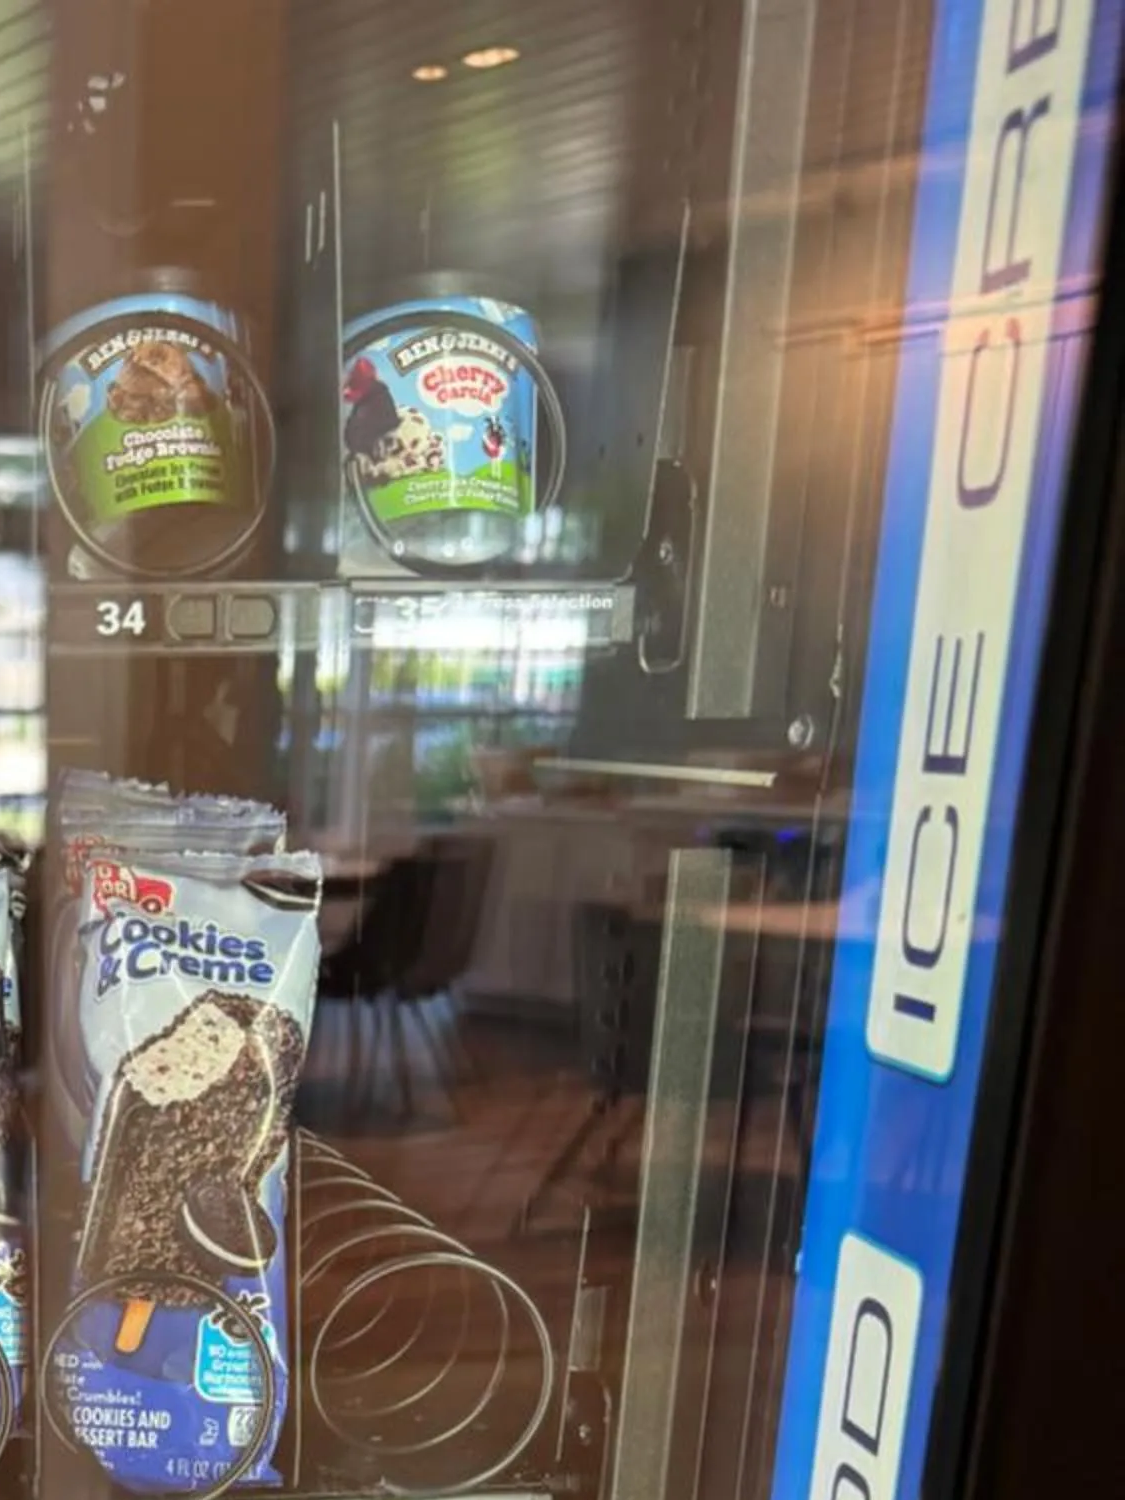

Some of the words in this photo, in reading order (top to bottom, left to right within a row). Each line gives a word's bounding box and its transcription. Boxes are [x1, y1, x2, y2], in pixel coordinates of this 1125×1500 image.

[88, 335, 126, 371] BEN
[397, 334, 440, 368] BEN
[422, 364, 508, 396] Cherry
[436, 385, 494, 406] Garcia
[123, 425, 205, 447] Chocolate
[106, 448, 154, 472] Fudge
[95, 602, 147, 636] 34
[892, 630, 985, 1022] ICE
[100, 918, 266, 961] Cookies
[126, 941, 275, 984] Creme
[66, 1386, 142, 1405] Crumbles!
[74, 1405, 135, 1428] COOKIES
[138, 1410, 172, 1429] AND
[127, 1429, 158, 1449] BAR
